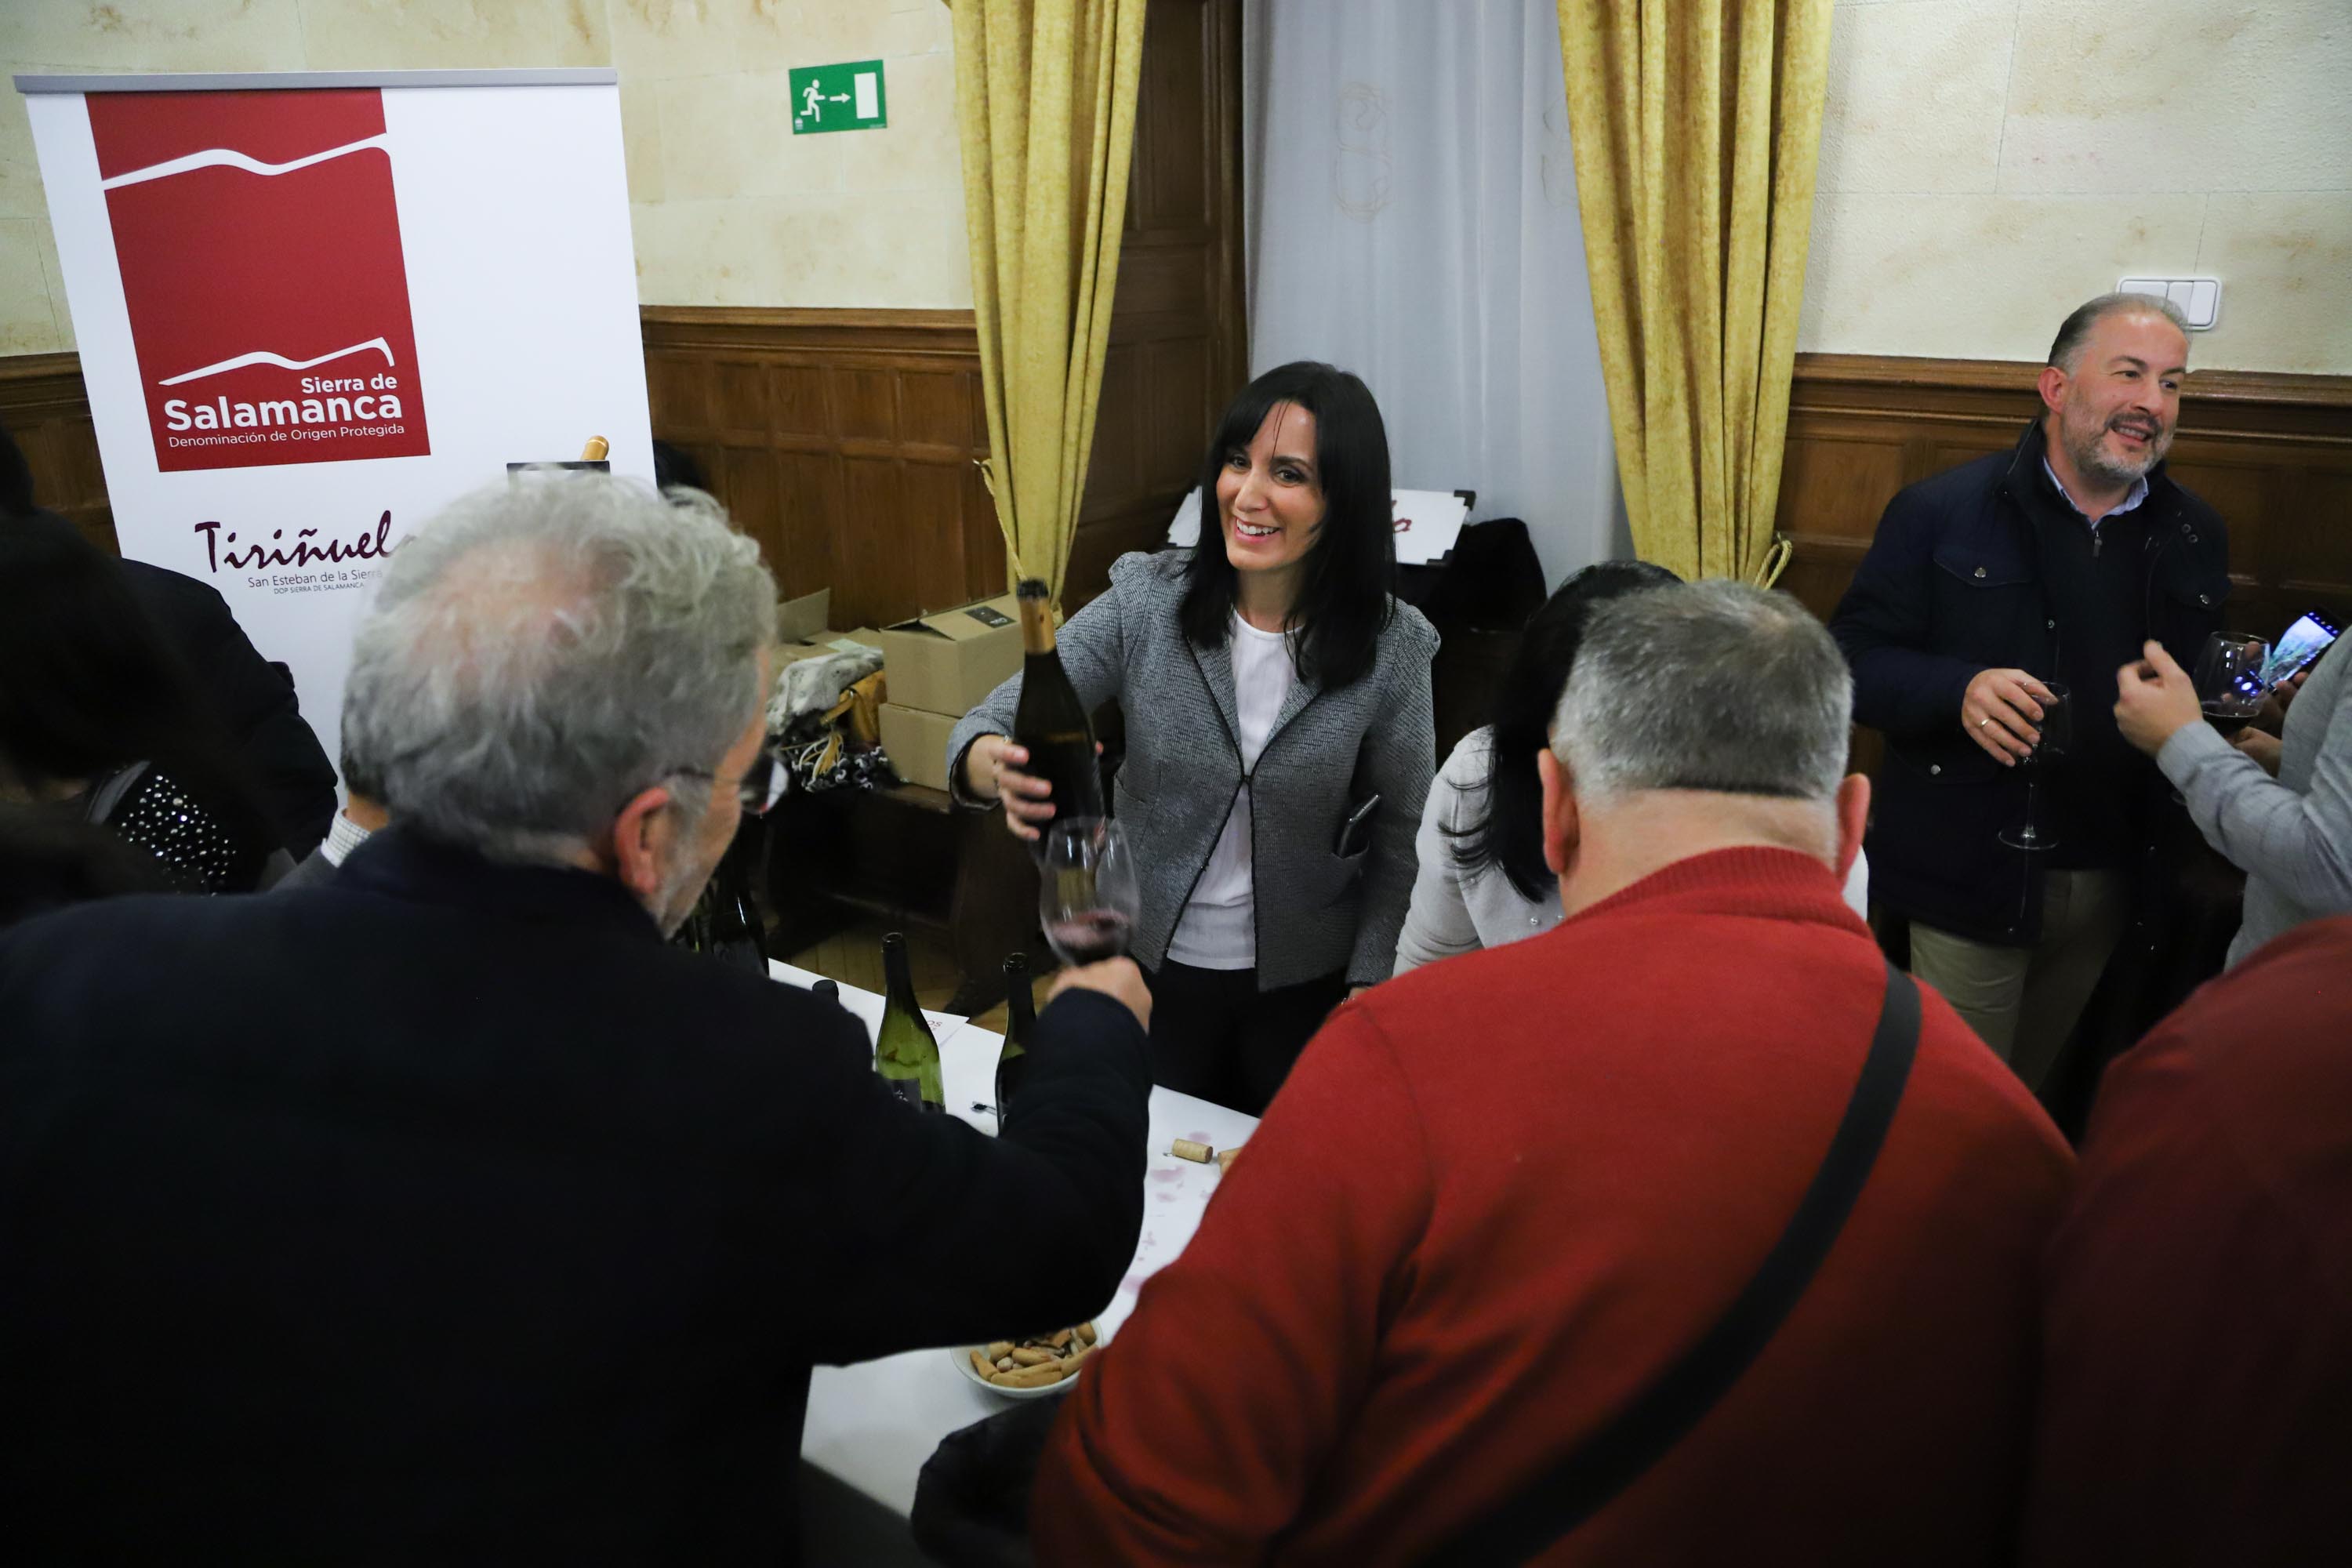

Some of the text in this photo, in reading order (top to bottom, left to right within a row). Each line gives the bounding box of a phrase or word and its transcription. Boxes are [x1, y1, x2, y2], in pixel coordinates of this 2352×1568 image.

[300, 372, 398, 394] Sierra de
[164, 394, 403, 431] Salamanca
[169, 424, 405, 448] Denominación de Origen Protegida
[248, 577, 269, 588] San
[272, 573, 317, 586] Esteban
[320, 572, 335, 583] de
[338, 571, 348, 581] la
[324, 582, 365, 590] SALAMANCA
